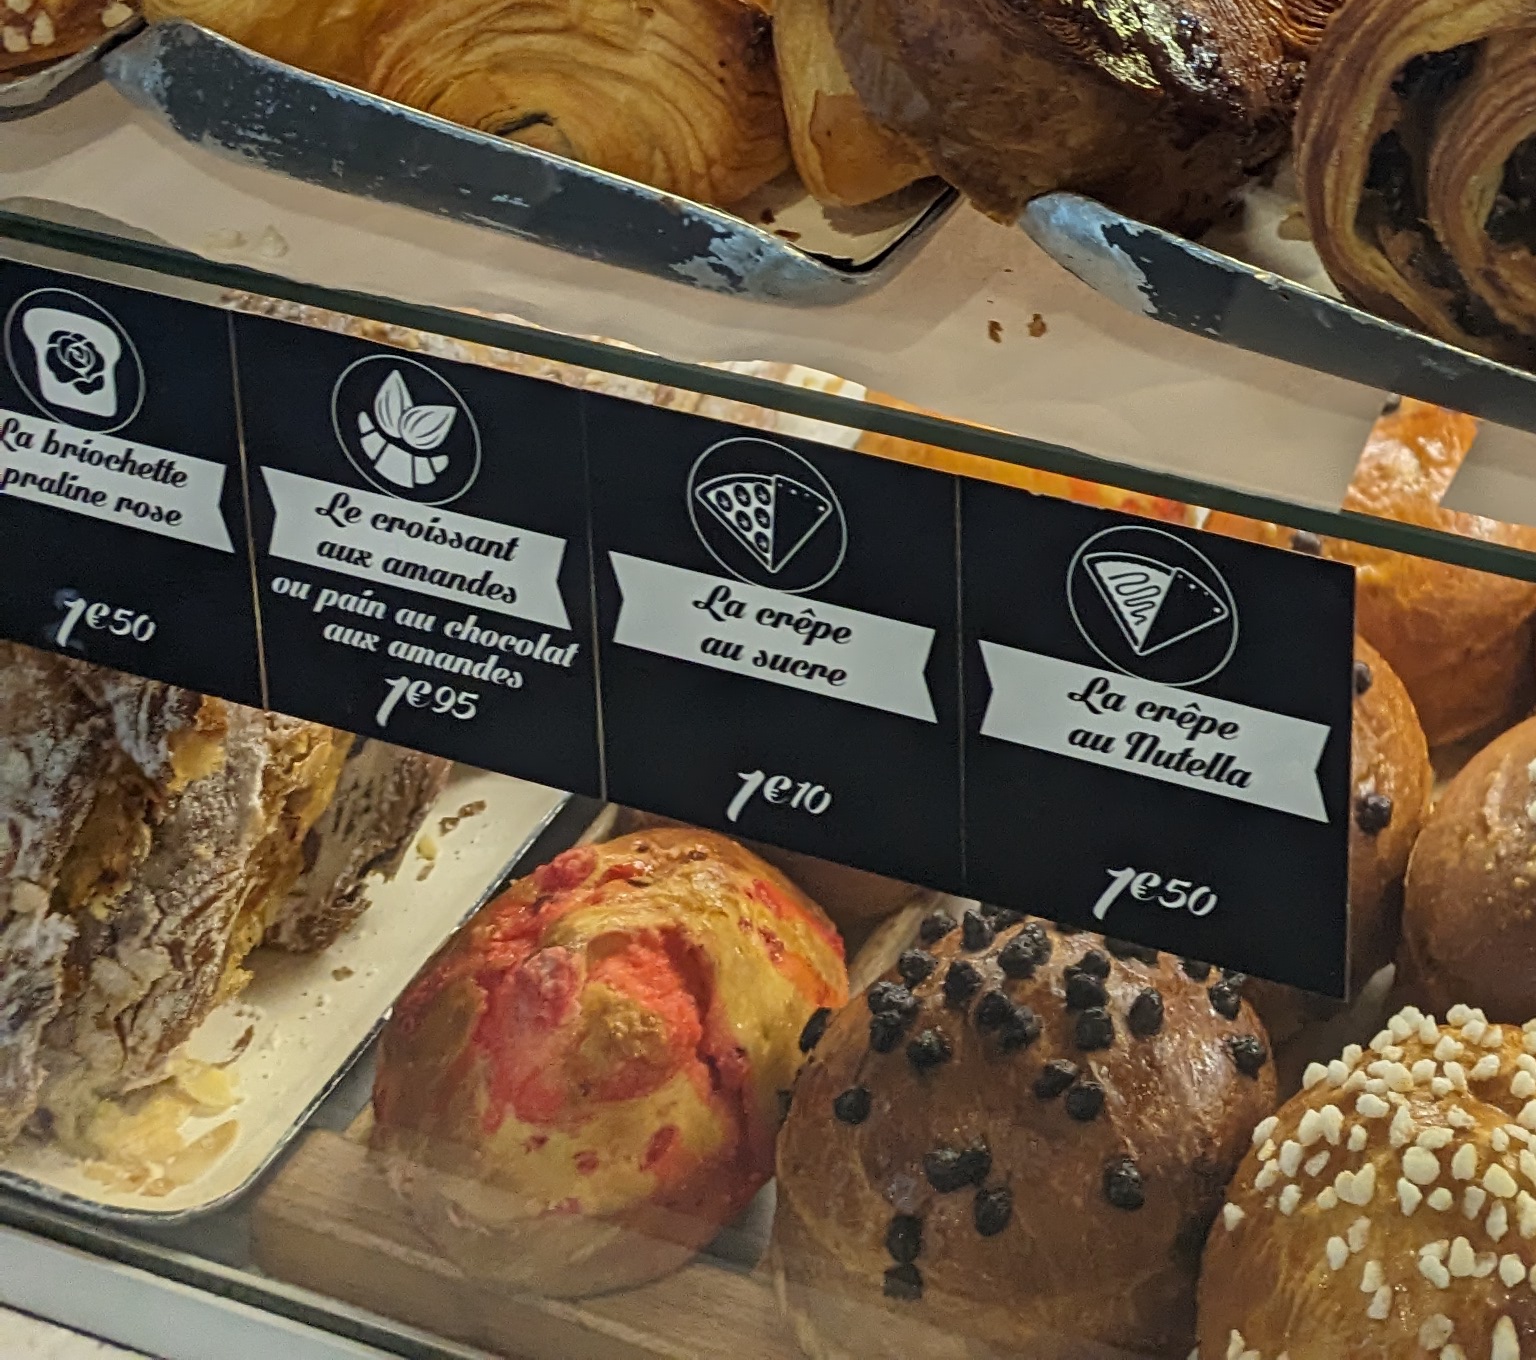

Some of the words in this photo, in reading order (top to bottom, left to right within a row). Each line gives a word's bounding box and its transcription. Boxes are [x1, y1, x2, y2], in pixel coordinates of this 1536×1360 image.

[0, 417, 35, 453] La
[40, 428, 188, 489] briochette
[0, 467, 108, 508] praline
[113, 496, 183, 527] rose
[314, 491, 363, 528] Le
[370, 513, 520, 562] croissant
[316, 540, 373, 569] aux
[381, 557, 518, 605] amandes
[271, 577, 311, 600] ou
[312, 588, 387, 620] pain
[394, 608, 437, 632] au
[443, 615, 580, 669] chocolat
[691, 584, 748, 623] La
[755, 607, 853, 646] crêpe
[323, 623, 380, 652] aux
[387, 638, 525, 689] amandes
[700, 636, 745, 662] au
[751, 649, 848, 687] sucre
[1066, 676, 1127, 715] La
[1135, 701, 1240, 742] crêpe
[1067, 728, 1116, 754] au
[1124, 731, 1253, 789] Nutella
